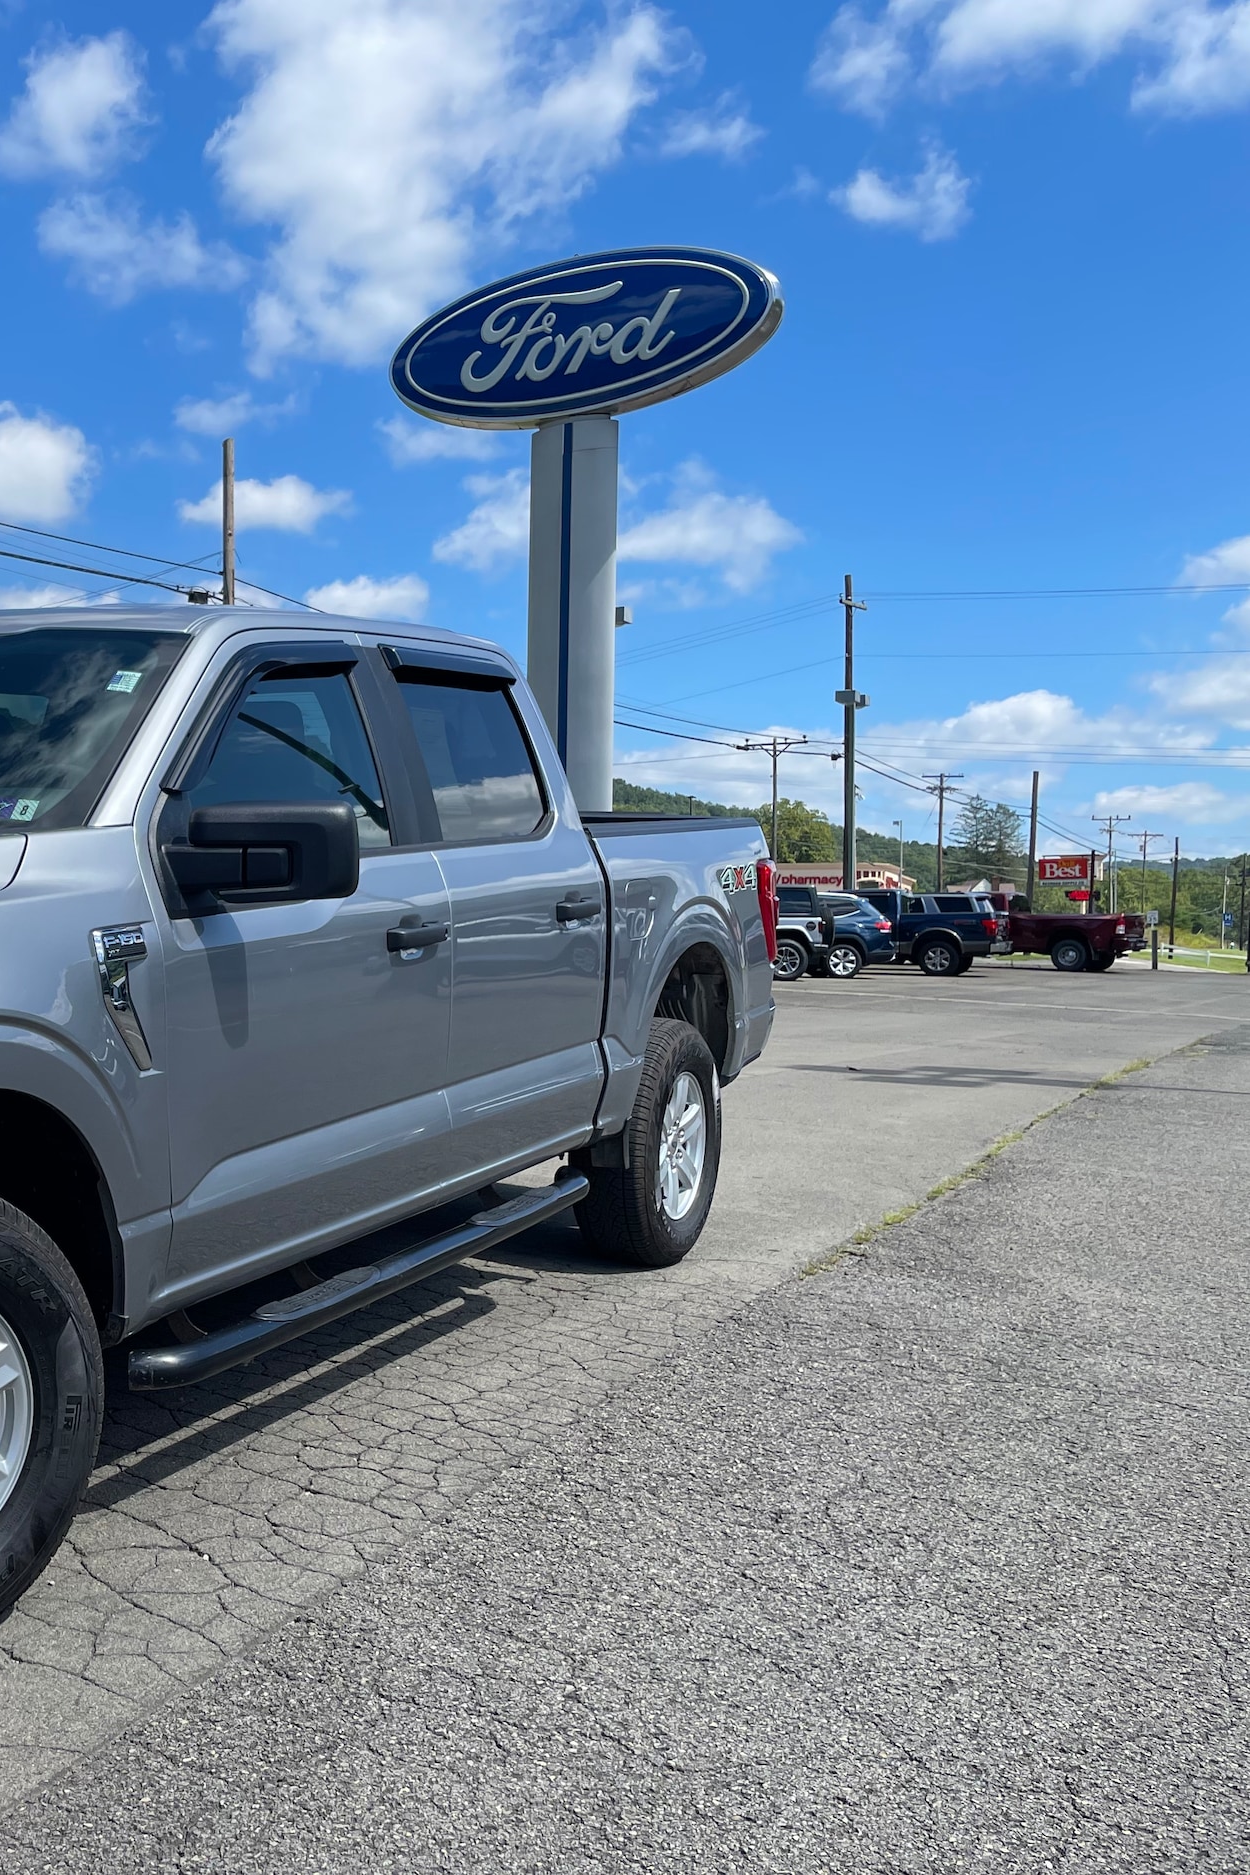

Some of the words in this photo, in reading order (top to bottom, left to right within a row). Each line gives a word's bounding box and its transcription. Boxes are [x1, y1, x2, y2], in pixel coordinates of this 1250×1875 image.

[460, 280, 682, 394] Ford
[20, 805, 29, 815] 8
[1044, 862, 1082, 878] Best
[103, 933, 144, 948] F-150
